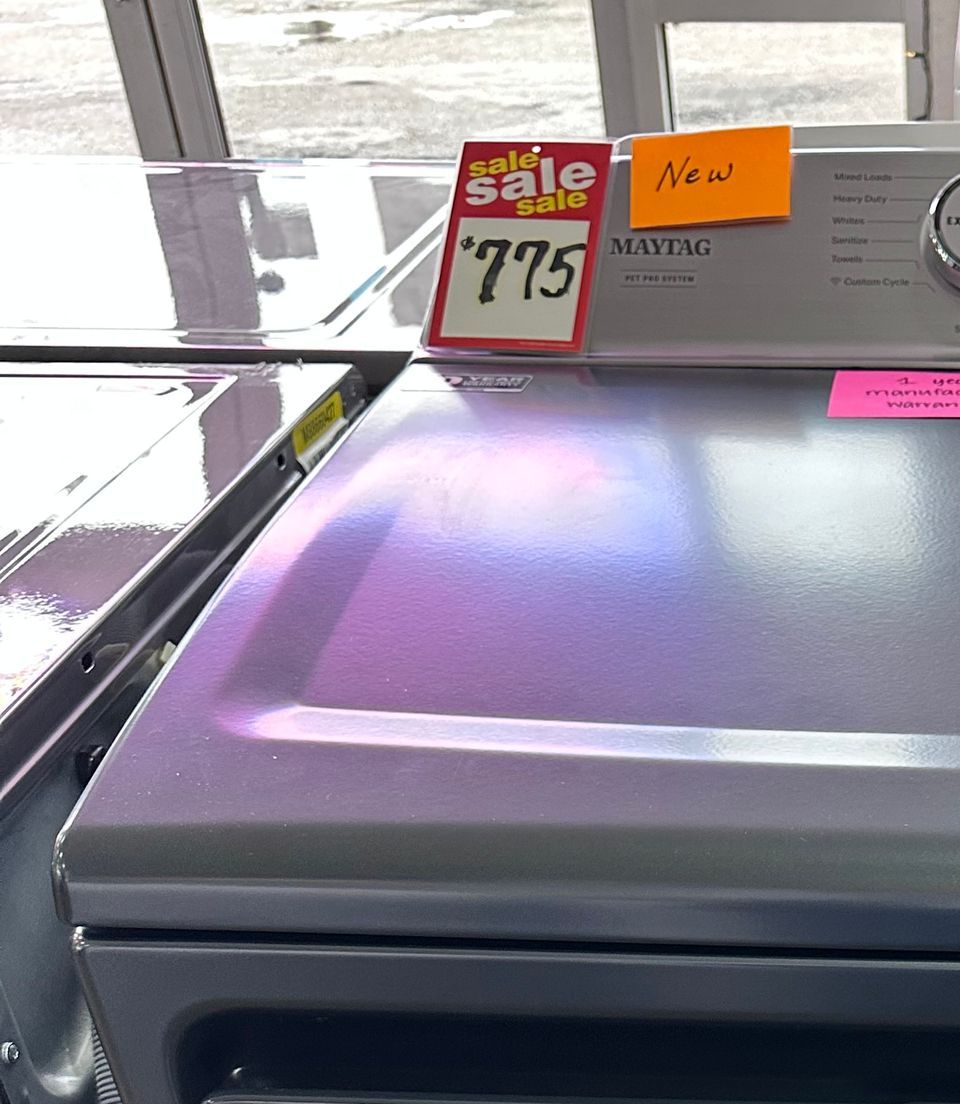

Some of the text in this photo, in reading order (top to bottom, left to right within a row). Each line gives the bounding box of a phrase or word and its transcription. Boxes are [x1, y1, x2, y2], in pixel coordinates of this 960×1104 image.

[469, 150, 540, 177] sale
[465, 157, 597, 206] sale
[656, 156, 733, 192] New
[515, 189, 588, 216] sale
[833, 194, 888, 205] Heavy Duty
[608, 237, 712, 257] MAYTAG
[625, 274, 641, 282] PET
[662, 275, 695, 283] SYSTEM
[843, 276, 911, 288] Custom Cycle
[896, 376, 917, 386] 1
